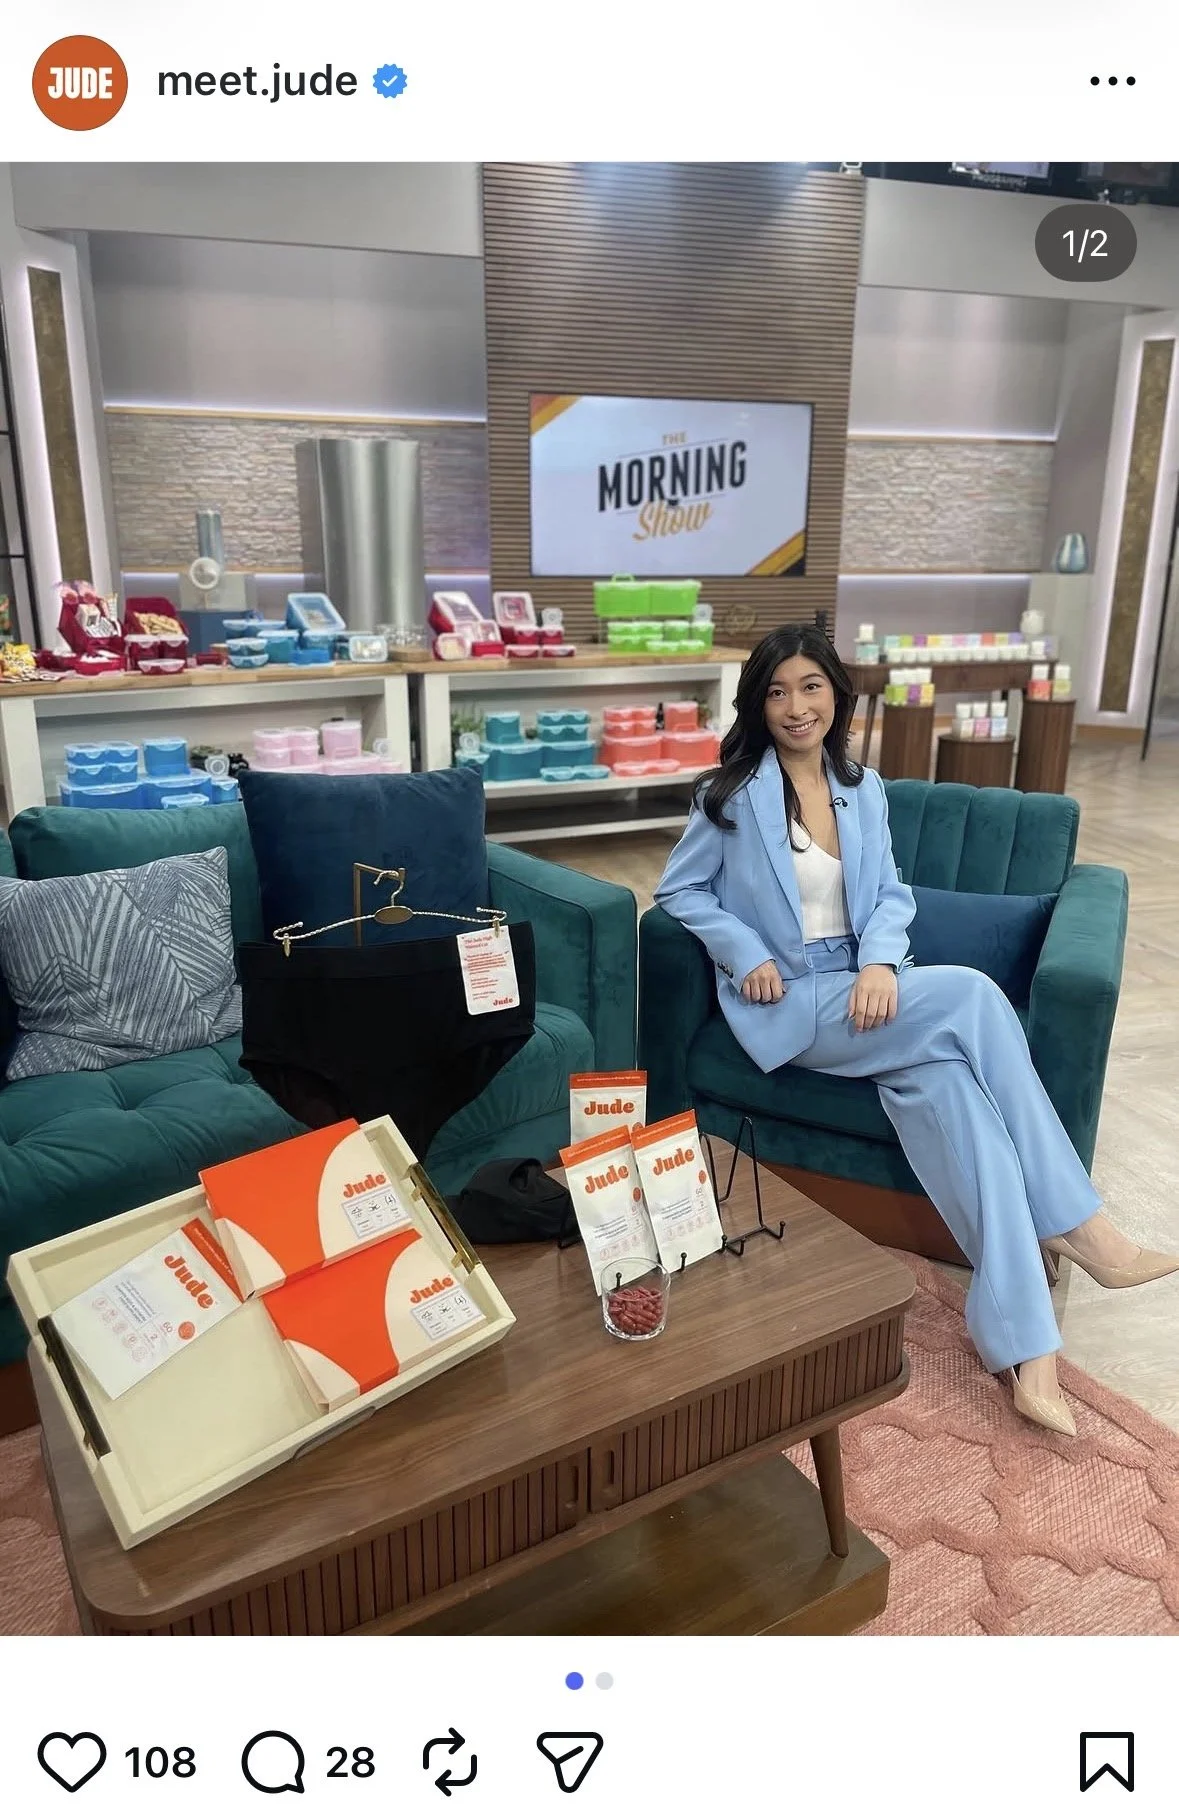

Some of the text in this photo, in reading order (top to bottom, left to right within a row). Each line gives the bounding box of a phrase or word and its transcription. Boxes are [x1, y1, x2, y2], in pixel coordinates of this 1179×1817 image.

[662, 431, 687, 445] THE
[598, 441, 747, 512] MORNING
[632, 500, 714, 541] Show
[493, 997, 513, 1006] Jude
[583, 1098, 635, 1117] Jude
[652, 1147, 695, 1176] Jude
[343, 1173, 387, 1199] Jude
[584, 1164, 630, 1194] Jude
[163, 1253, 214, 1309] Jude
[410, 1276, 455, 1304] Jude
